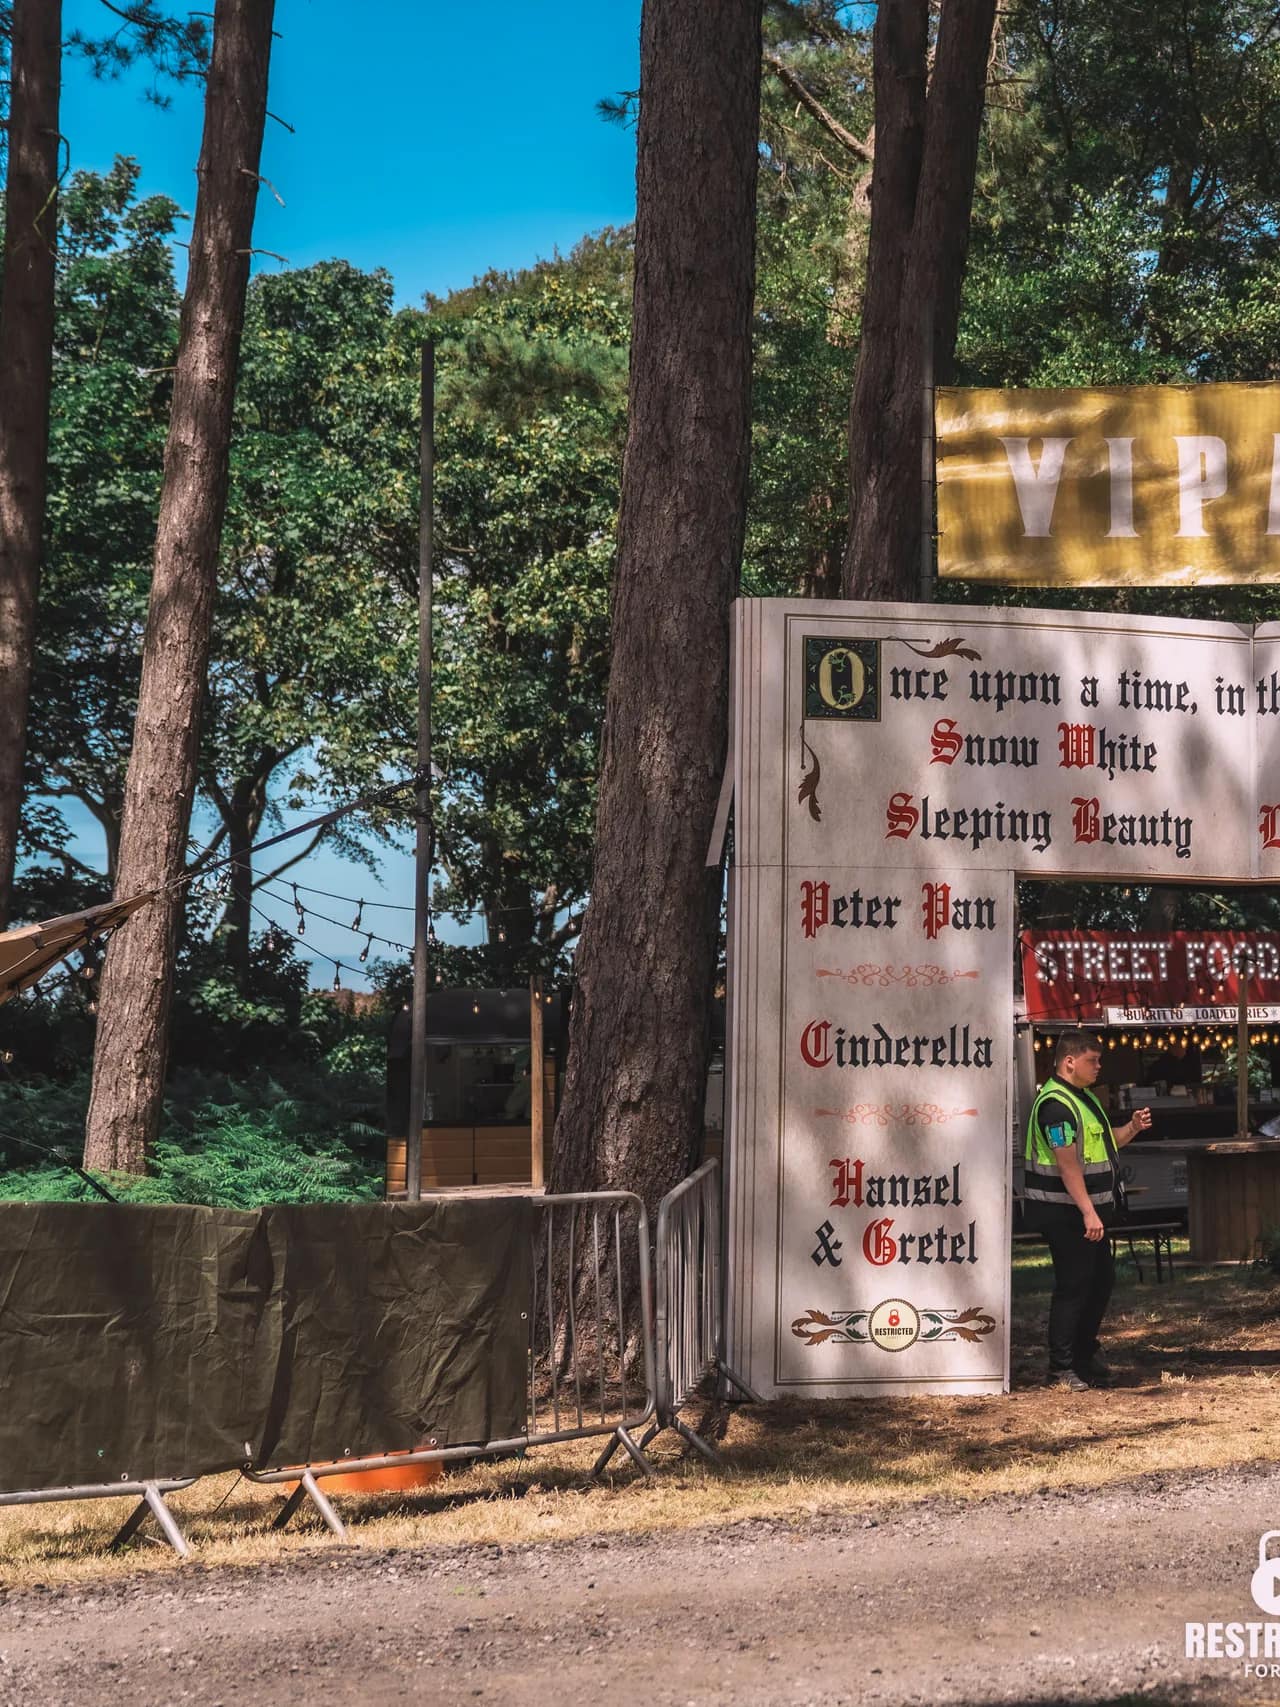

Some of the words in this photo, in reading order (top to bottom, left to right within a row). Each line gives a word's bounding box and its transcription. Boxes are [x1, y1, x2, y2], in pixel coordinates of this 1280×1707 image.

[819, 648, 948, 710] Once
[969, 668, 1061, 712] upon
[1080, 678, 1100, 708] a
[1118, 671, 1198, 715] time,
[1214, 677, 1246, 715] in
[929, 718, 1039, 767] Snow
[1058, 722, 1158, 781] White
[885, 792, 1053, 853] Sleeping
[1071, 797, 1193, 859] Beauty
[800, 880, 901, 940] Peter
[922, 881, 996, 940] Pan
[1034, 941, 1172, 982] STREET
[1185, 941, 1280, 982] FOOD
[1196, 1008, 1237, 1020] LOADED
[1246, 1007, 1269, 1019] RIES
[800, 1020, 994, 1069] Cinderella
[829, 1158, 963, 1209] Hansel
[811, 1219, 843, 1267] &
[862, 1217, 979, 1267] Gretel
[874, 1327, 914, 1336] RESTRICTED
